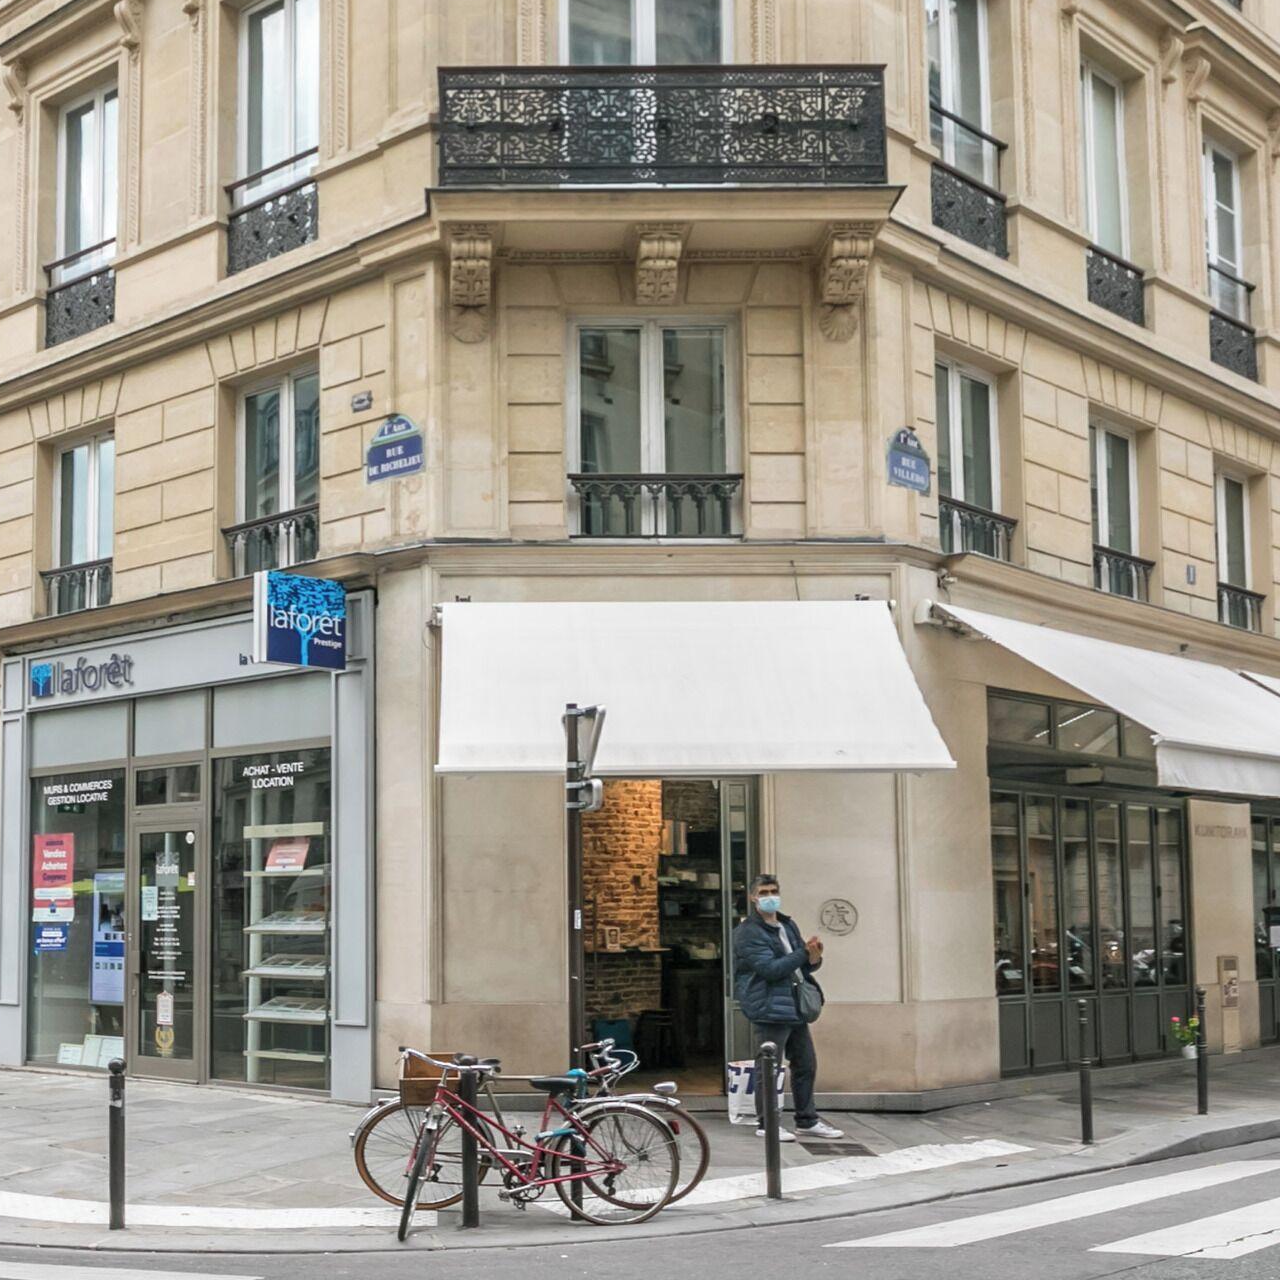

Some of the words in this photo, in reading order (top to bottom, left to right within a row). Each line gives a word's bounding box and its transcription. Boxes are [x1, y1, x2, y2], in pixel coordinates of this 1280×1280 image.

[386, 445, 404, 458] RUE
[369, 465, 379, 477] DE
[380, 454, 422, 473] RICHELIEU
[901, 456, 916, 470] RUE
[270, 601, 342, 637] laforêt
[313, 637, 342, 649] Prestige
[56, 653, 135, 696] laforêt
[242, 765, 271, 777] ACHAT
[276, 761, 305, 774] VENTE
[43, 785, 63, 795] MURS
[69, 780, 113, 793] COMMERCES
[252, 776, 294, 789] LOCATION
[47, 793, 76, 806] GESTION
[76, 791, 109, 803] LOCATIVE
